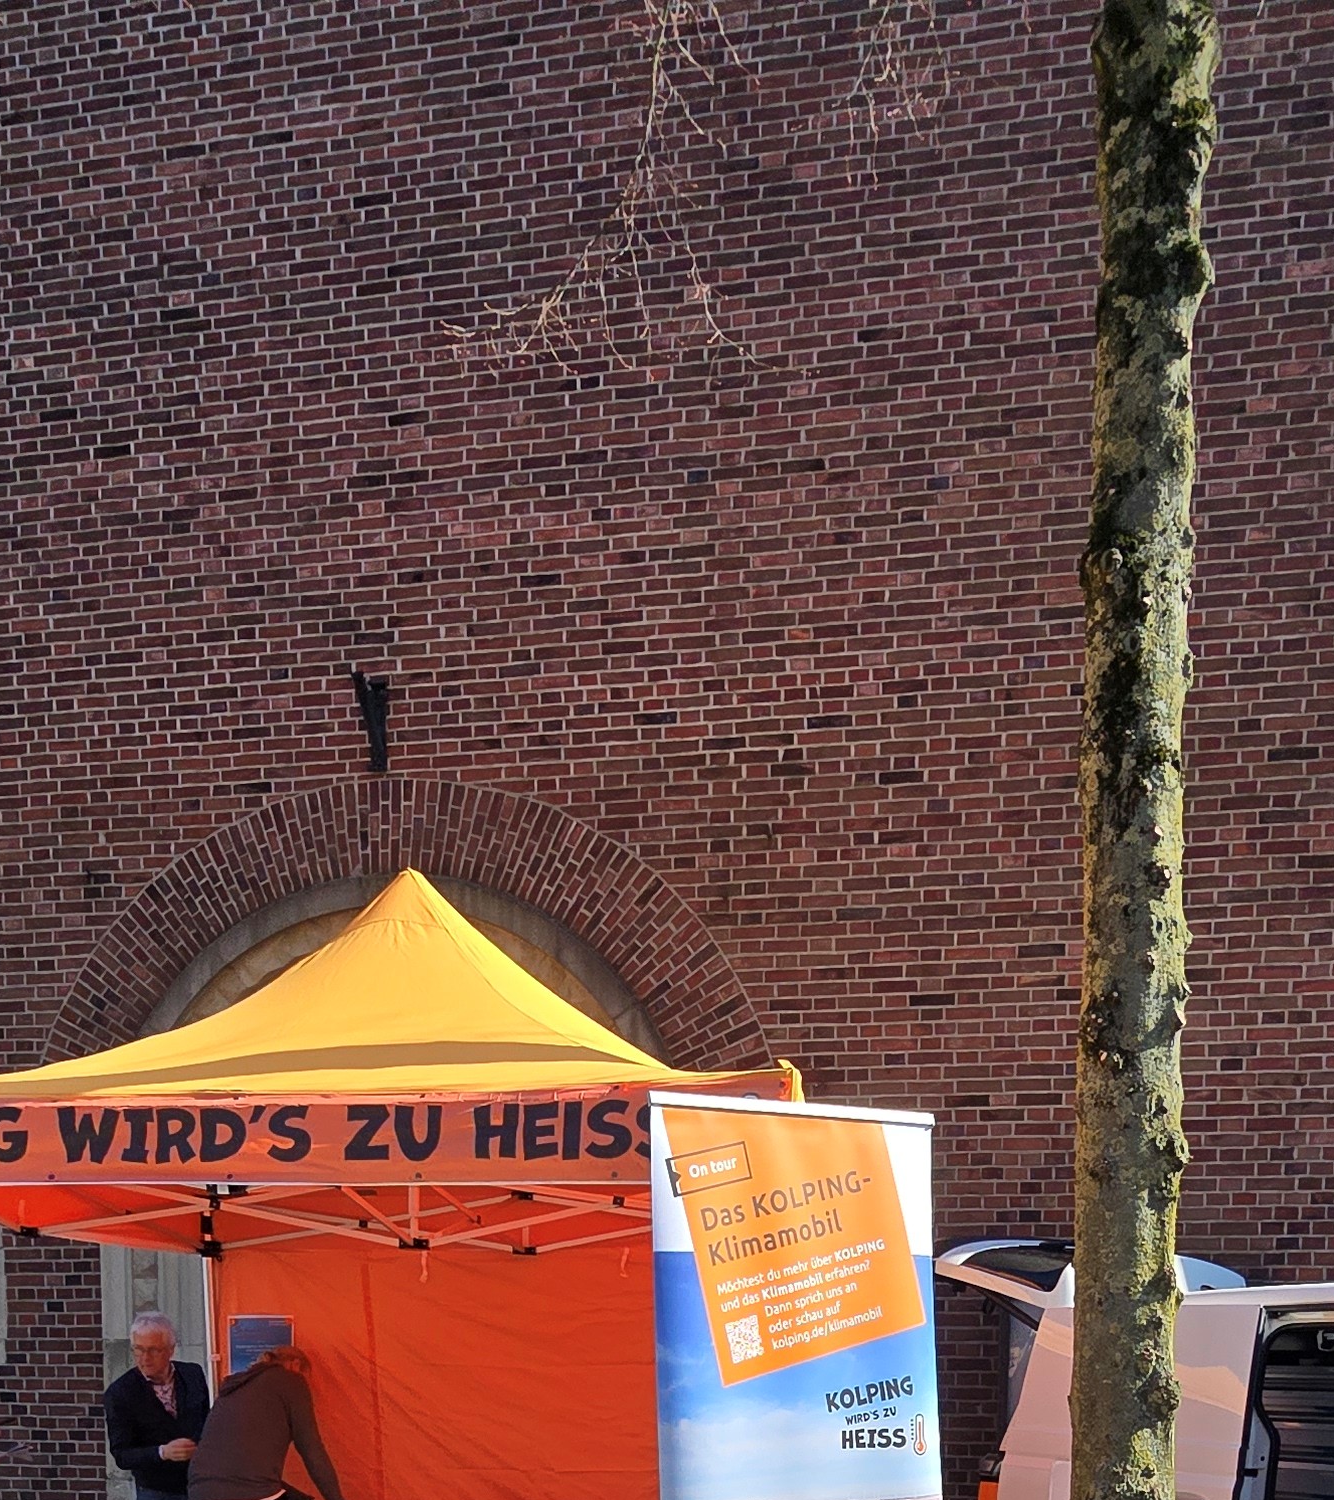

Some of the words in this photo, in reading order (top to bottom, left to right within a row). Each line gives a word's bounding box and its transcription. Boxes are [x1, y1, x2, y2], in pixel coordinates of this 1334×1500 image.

[59, 1105, 313, 1164] WIRD'S
[344, 1105, 442, 1162] ZU
[688, 1164, 708, 1178] On
[710, 1157, 737, 1174] tour
[700, 1204, 746, 1232] Das
[751, 1170, 872, 1218] KOLPING-
[708, 1208, 843, 1267] Klimamobil
[717, 1273, 765, 1296] Möchtest
[767, 1269, 782, 1282] du
[783, 1261, 809, 1277] mehr
[811, 1254, 834, 1269] über
[834, 1239, 886, 1263] KOLPING
[720, 1298, 740, 1313] und
[742, 1293, 761, 1306] das
[761, 1272, 824, 1300] Klimamobil
[825, 1259, 871, 1282] erfahren?
[764, 1301, 793, 1317] Dann
[794, 1291, 824, 1309] sprich
[826, 1285, 843, 1298] uns
[845, 1282, 858, 1293] an
[768, 1319, 793, 1334] oder
[795, 1310, 824, 1327] schau
[825, 1301, 842, 1317] auf
[771, 1305, 884, 1350] kolping.de/klimamobil
[825, 1375, 914, 1413] KOLPING
[845, 1410, 880, 1426] WIRD'S
[883, 1406, 897, 1418] ZU
[841, 1428, 907, 1449] HEISS
